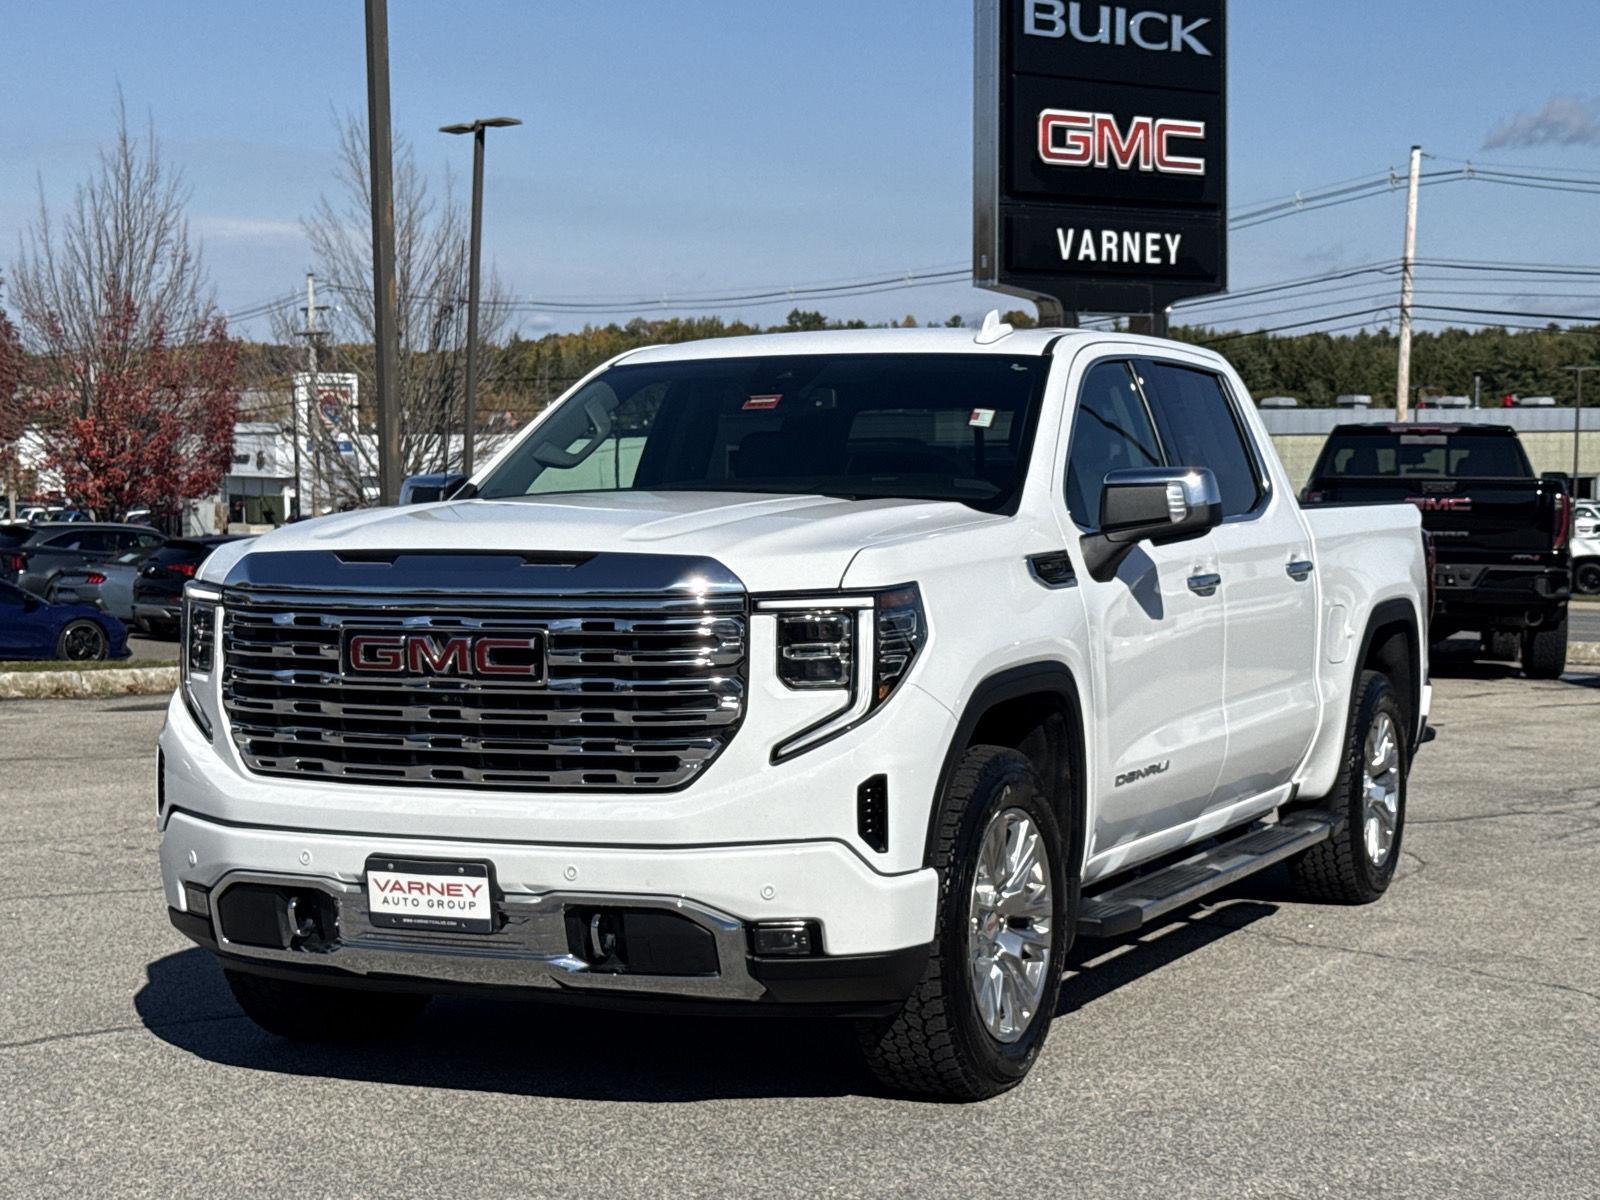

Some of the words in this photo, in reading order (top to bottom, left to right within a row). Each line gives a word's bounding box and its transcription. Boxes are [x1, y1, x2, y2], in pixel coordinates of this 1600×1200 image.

[1023, 0, 1213, 56] BUICK
[1038, 108, 1205, 175] GMC
[1056, 227, 1182, 265] VARNEY
[350, 635, 535, 675] GMC
[1114, 759, 1170, 788] DENALI
[373, 878, 483, 898] VARNEY
[382, 896, 420, 907] AUTO
[427, 898, 477, 910] GROUP
